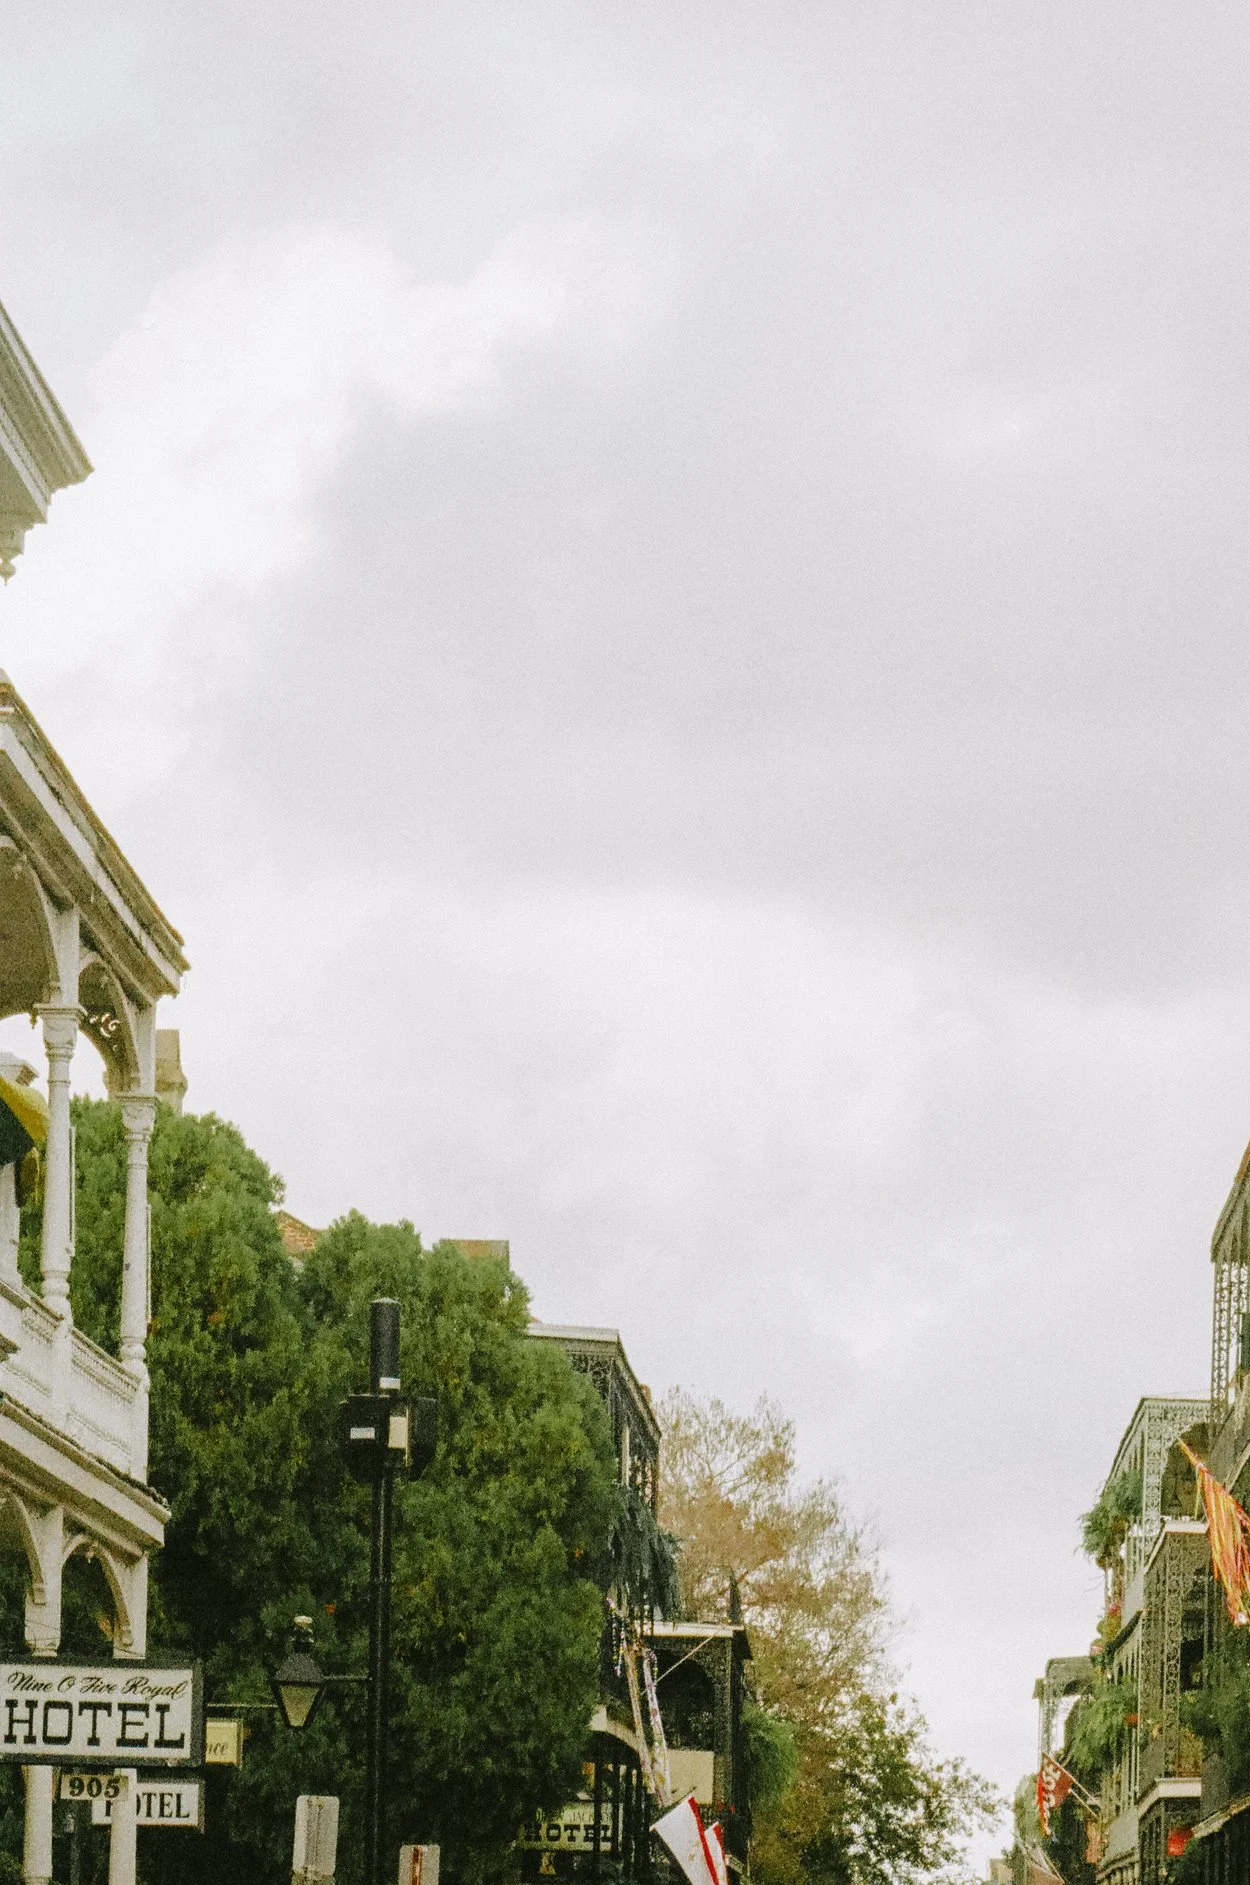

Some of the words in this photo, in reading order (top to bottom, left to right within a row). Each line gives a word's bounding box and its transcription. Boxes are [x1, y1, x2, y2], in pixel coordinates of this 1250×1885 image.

[7, 1671, 53, 1693] Nine
[78, 1676, 118, 1695] Five
[121, 1676, 189, 1700] Royal
[3, 1699, 186, 1749] HOTEL
[68, 1776, 122, 1799] 905
